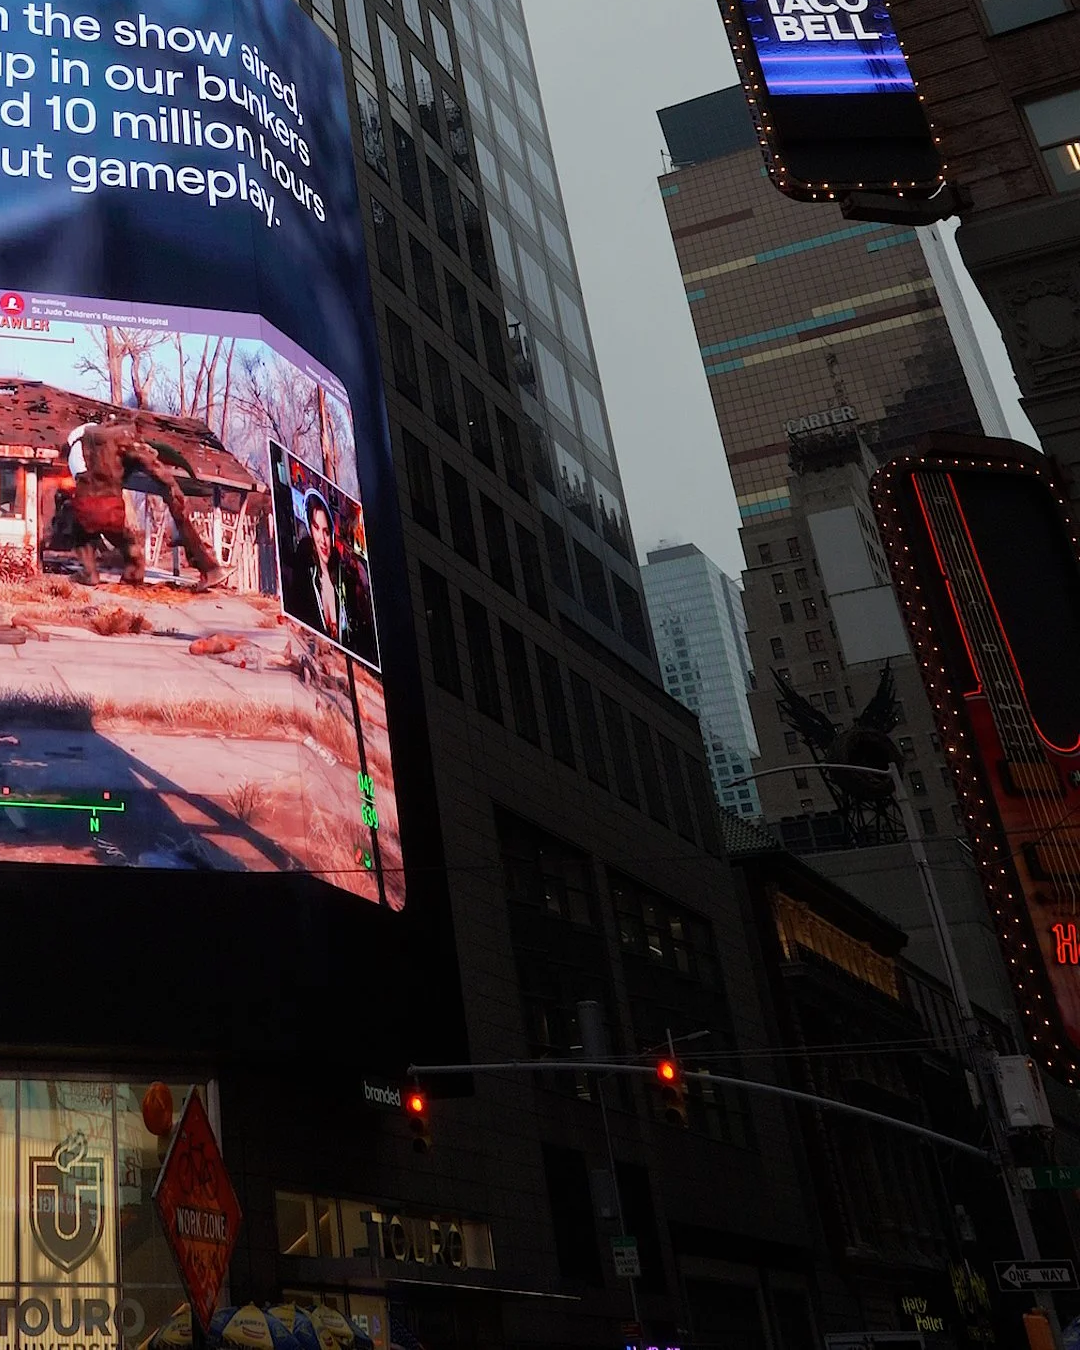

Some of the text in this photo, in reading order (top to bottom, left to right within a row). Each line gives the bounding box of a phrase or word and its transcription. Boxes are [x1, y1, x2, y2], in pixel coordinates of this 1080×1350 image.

[773, 14, 881, 42] BELL
[23, 2, 100, 41] the
[114, 14, 232, 57] show
[241, 40, 305, 125] aired,
[51, 47, 90, 86] in
[105, 63, 185, 96] our
[198, 66, 310, 167] bunkers
[46, 95, 96, 135] 10
[113, 108, 255, 152] million
[262, 138, 327, 223] hours
[68, 154, 282, 228] gameplay.
[44, 308, 62, 316] Jude
[64, 310, 100, 320] Children's
[103, 313, 136, 323] Research
[138, 316, 168, 326] Hospital
[787, 406, 854, 434] CARTER
[89, 818, 100, 832] N
[361, 803, 379, 829] 639
[177, 1206, 226, 1240] WORK ZONE
[1009, 1269, 1065, 1281] ONE WAY
